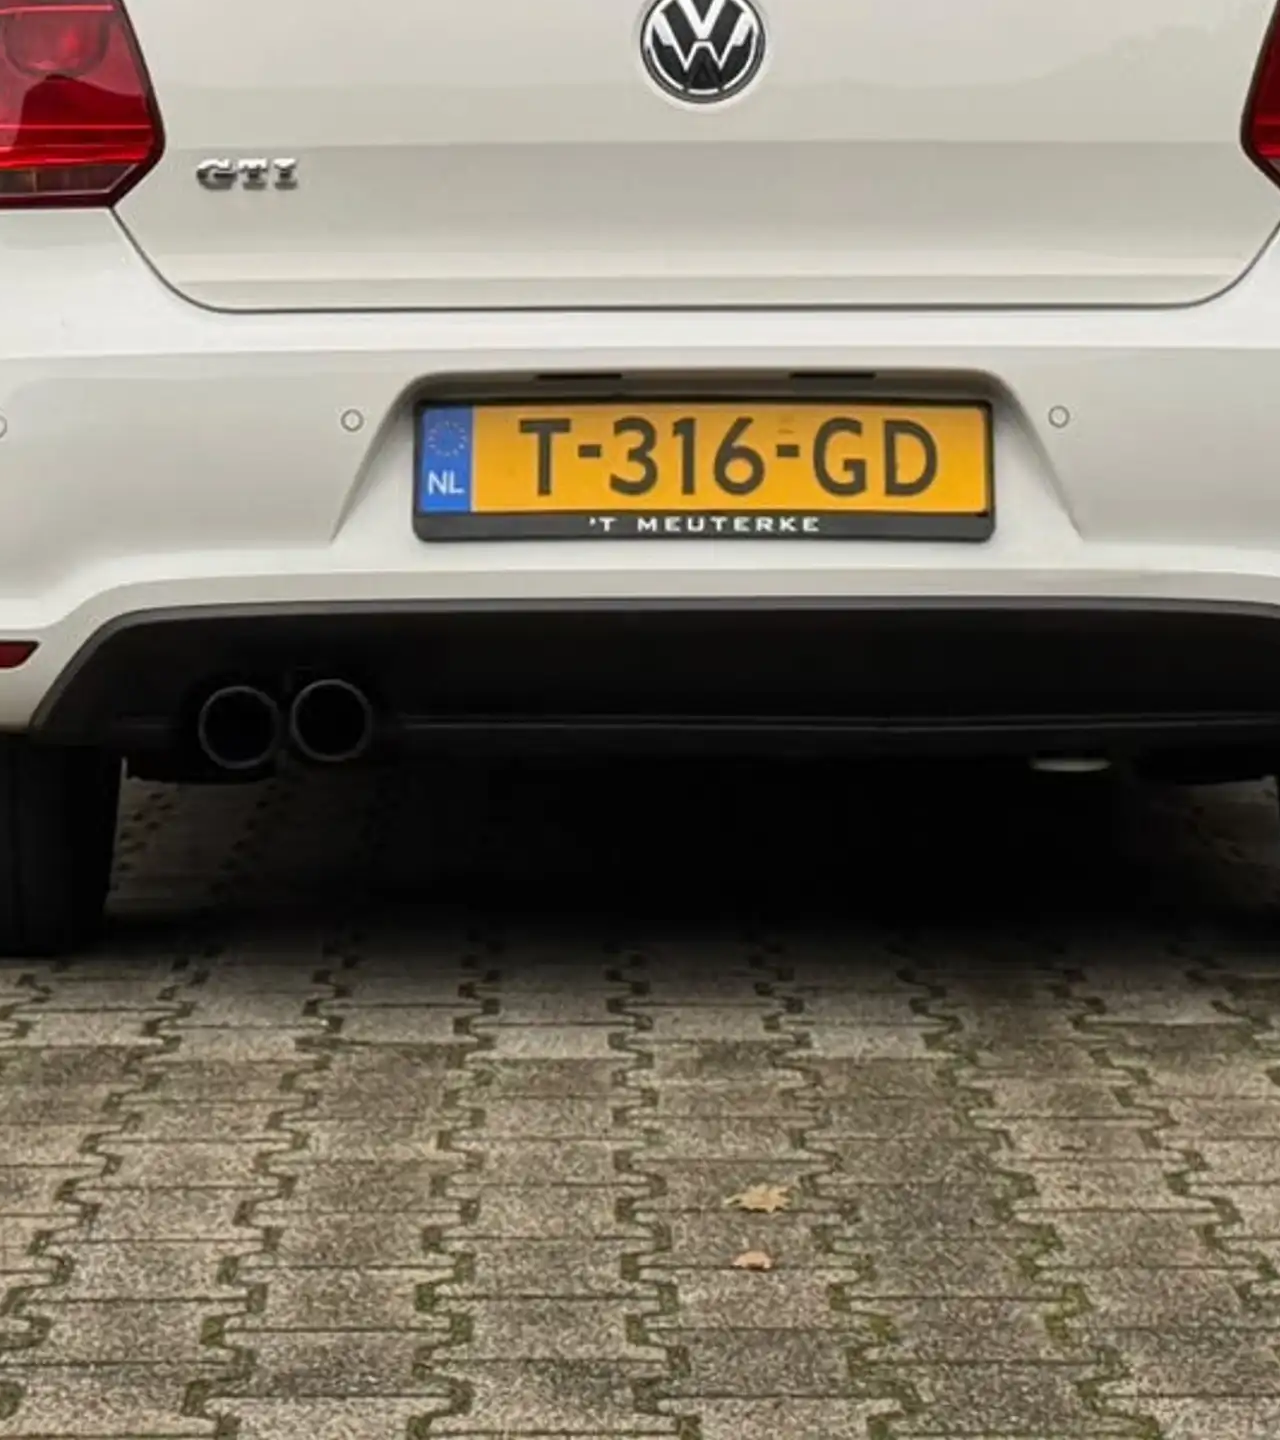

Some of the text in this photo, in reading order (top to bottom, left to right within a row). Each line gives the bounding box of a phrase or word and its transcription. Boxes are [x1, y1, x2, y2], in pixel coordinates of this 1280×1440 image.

[195, 157, 299, 192] GTI
[427, 416, 939, 498] NL T-316-GD
[637, 516, 821, 532] MEUTERKE
